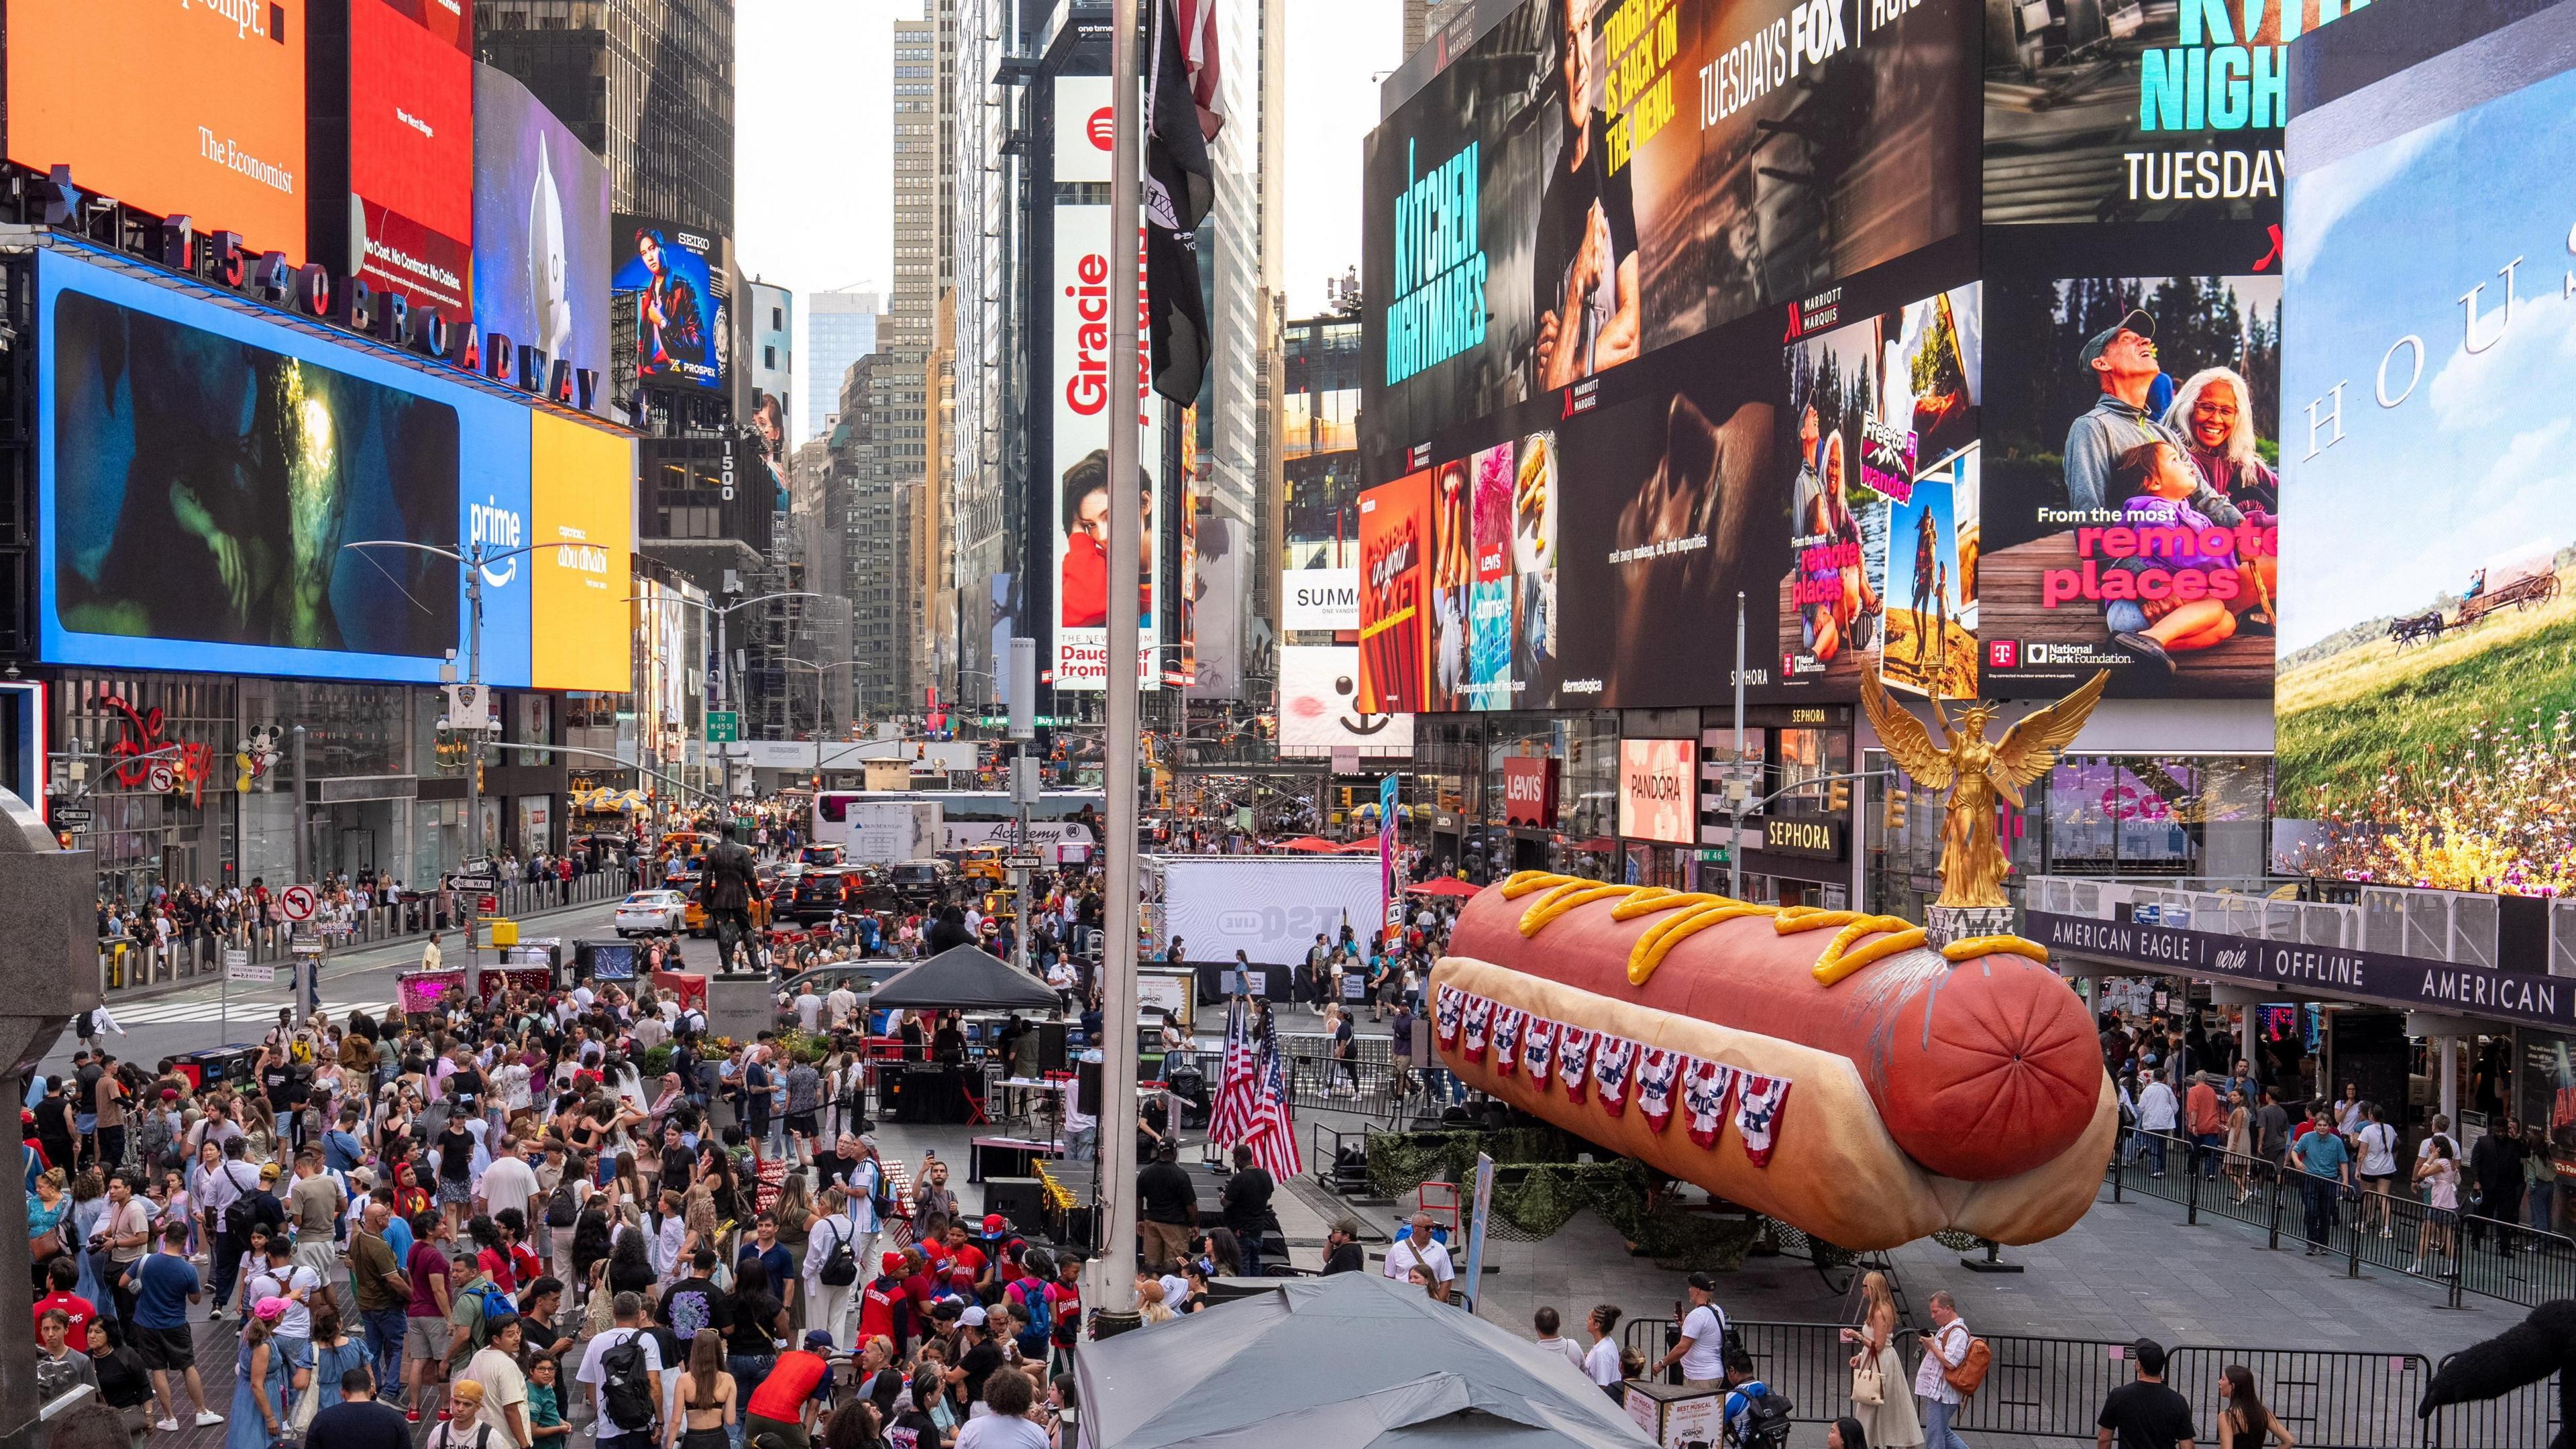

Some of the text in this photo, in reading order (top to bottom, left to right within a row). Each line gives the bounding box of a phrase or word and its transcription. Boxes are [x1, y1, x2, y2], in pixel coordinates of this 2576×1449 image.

[1448, 5, 1475, 40] MARRIOTT
[1448, 28, 1472, 58] MARQUIS
[1604, 0, 1648, 66] TOUGH
[1604, 69, 1619, 125] IS
[1620, 34, 1657, 105] BACK
[1657, 5, 1678, 69] ON
[1699, 0, 1846, 130] TUESDAYS FOX
[396, 107, 408, 123] Your
[408, 113, 420, 131] Next
[1605, 70, 1676, 177] THE MENU.
[199, 125, 292, 194] The Economist
[1395, 137, 1478, 300] KITCHEN
[678, 233, 709, 251] SEIKO
[686, 247, 696, 256] SINCE
[364, 236, 462, 291] No Cost. No Contract. No Cables.
[1804, 286, 1842, 312] MARRIOTT
[163, 215, 599, 410] 1540 BROADWAY
[1387, 250, 1487, 386] NIGHTMARES
[1804, 307, 1837, 331] MARQUIS
[1065, 254, 1108, 415] Gracie
[735, 324, 751, 374] GUCCI
[684, 362, 716, 378] PROSPEX
[1574, 378, 1599, 397] MARRIOTT
[1574, 394, 1597, 412] MARQUIS
[1864, 411, 1903, 451] Free to
[1414, 441, 1432, 455] MARRIOTT
[721, 441, 734, 500] 1500
[1414, 455, 1430, 468] MARQUIS
[1861, 464, 1912, 504] wander
[1362, 498, 1375, 514] verizon
[2037, 507, 2176, 523] From the most
[470, 494, 521, 548] prime
[558, 525, 586, 540] experience
[1792, 534, 1827, 548] From the most
[1366, 527, 1392, 568] CASH
[1609, 533, 1708, 564] melt away makeup, oil, and impurities
[1801, 538, 1859, 572] remote
[557, 544, 607, 574] abu dhabi
[1373, 541, 1409, 601] in your
[1792, 574, 1844, 612] places
[2042, 561, 2241, 608] places
[1297, 588, 1359, 606] SUMM
[1475, 598, 1505, 620] summer
[1061, 645, 1151, 664] Daugr
[2049, 643, 2092, 654] National
[2049, 653, 2131, 664] Park Foundation
[1061, 661, 1106, 677] from
[1801, 654, 1815, 664] National
[1801, 662, 1809, 672] Park
[1463, 684, 1471, 696] your
[1511, 679, 1525, 694] Square
[1562, 678, 1602, 694] dermalogica
[1037, 717, 1054, 727] Buy
[1792, 709, 1825, 722] SEPHORA
[1631, 773, 1682, 802] PANDORA
[741, 818, 749, 826] 46
[1437, 816, 1452, 826] swatch
[2126, 822, 2144, 831] on
[533, 833, 545, 843] COMING
[990, 824, 1061, 843] Acaemy
[1769, 820, 1831, 851] SEPHORA
[1703, 851, 1723, 860] W 46
[453, 879, 490, 888] ONE WAY
[316, 921, 354, 930] TIMES SQUARE
[2053, 921, 2365, 987] AMERICAN EAGLE aerie OFFLINE
[2420, 969, 2557, 1015] AMERICAN
[1690, 1401, 1711, 1410] MUSICAL
[1682, 1429, 1702, 1438] MORMON
